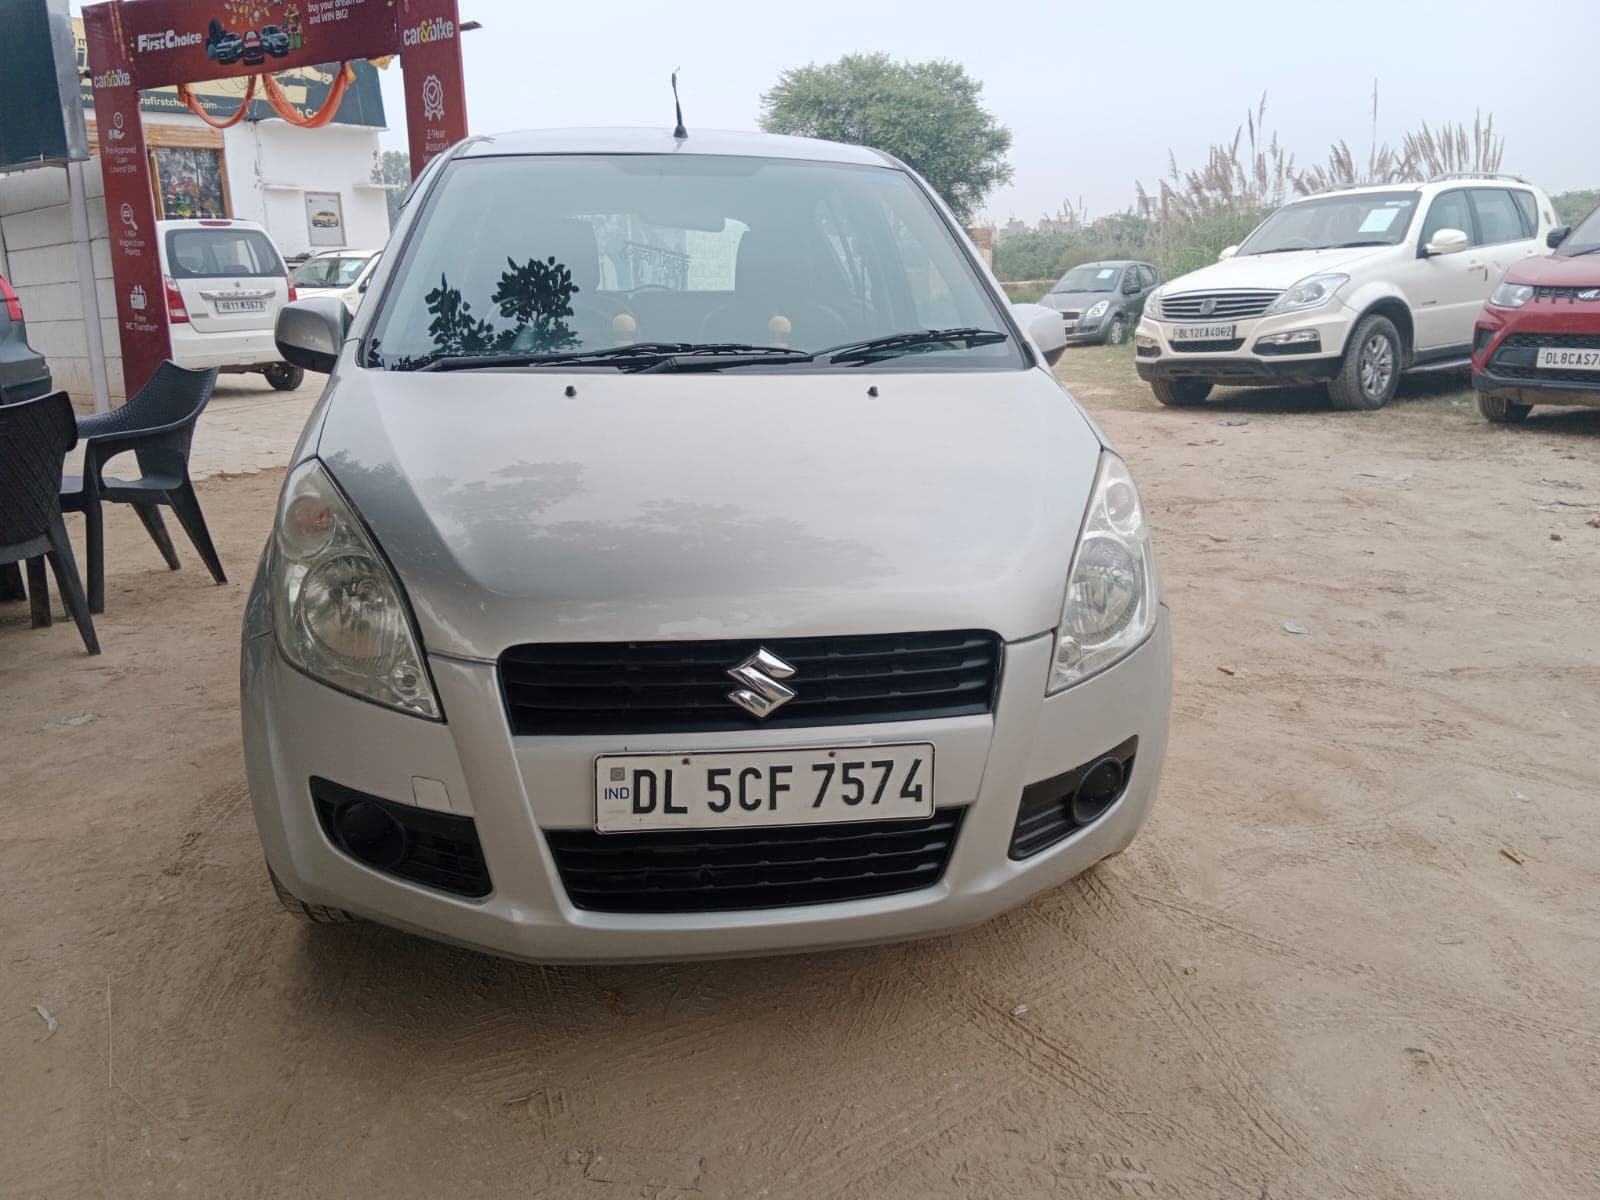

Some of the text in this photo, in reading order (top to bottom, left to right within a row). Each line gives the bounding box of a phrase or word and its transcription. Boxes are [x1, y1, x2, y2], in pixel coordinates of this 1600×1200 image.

[308, 2, 320, 13] buy
[320, 0, 333, 12] your
[309, 9, 348, 24] and WIN BIG!
[403, 16, 454, 46] car&bike
[93, 68, 131, 89] car&bike
[427, 129, 446, 140] 2-Year
[134, 313, 147, 323] Free
[1545, 352, 1600, 367] DL8CAS7
[604, 758, 923, 814] IND DL 5CF 7574
